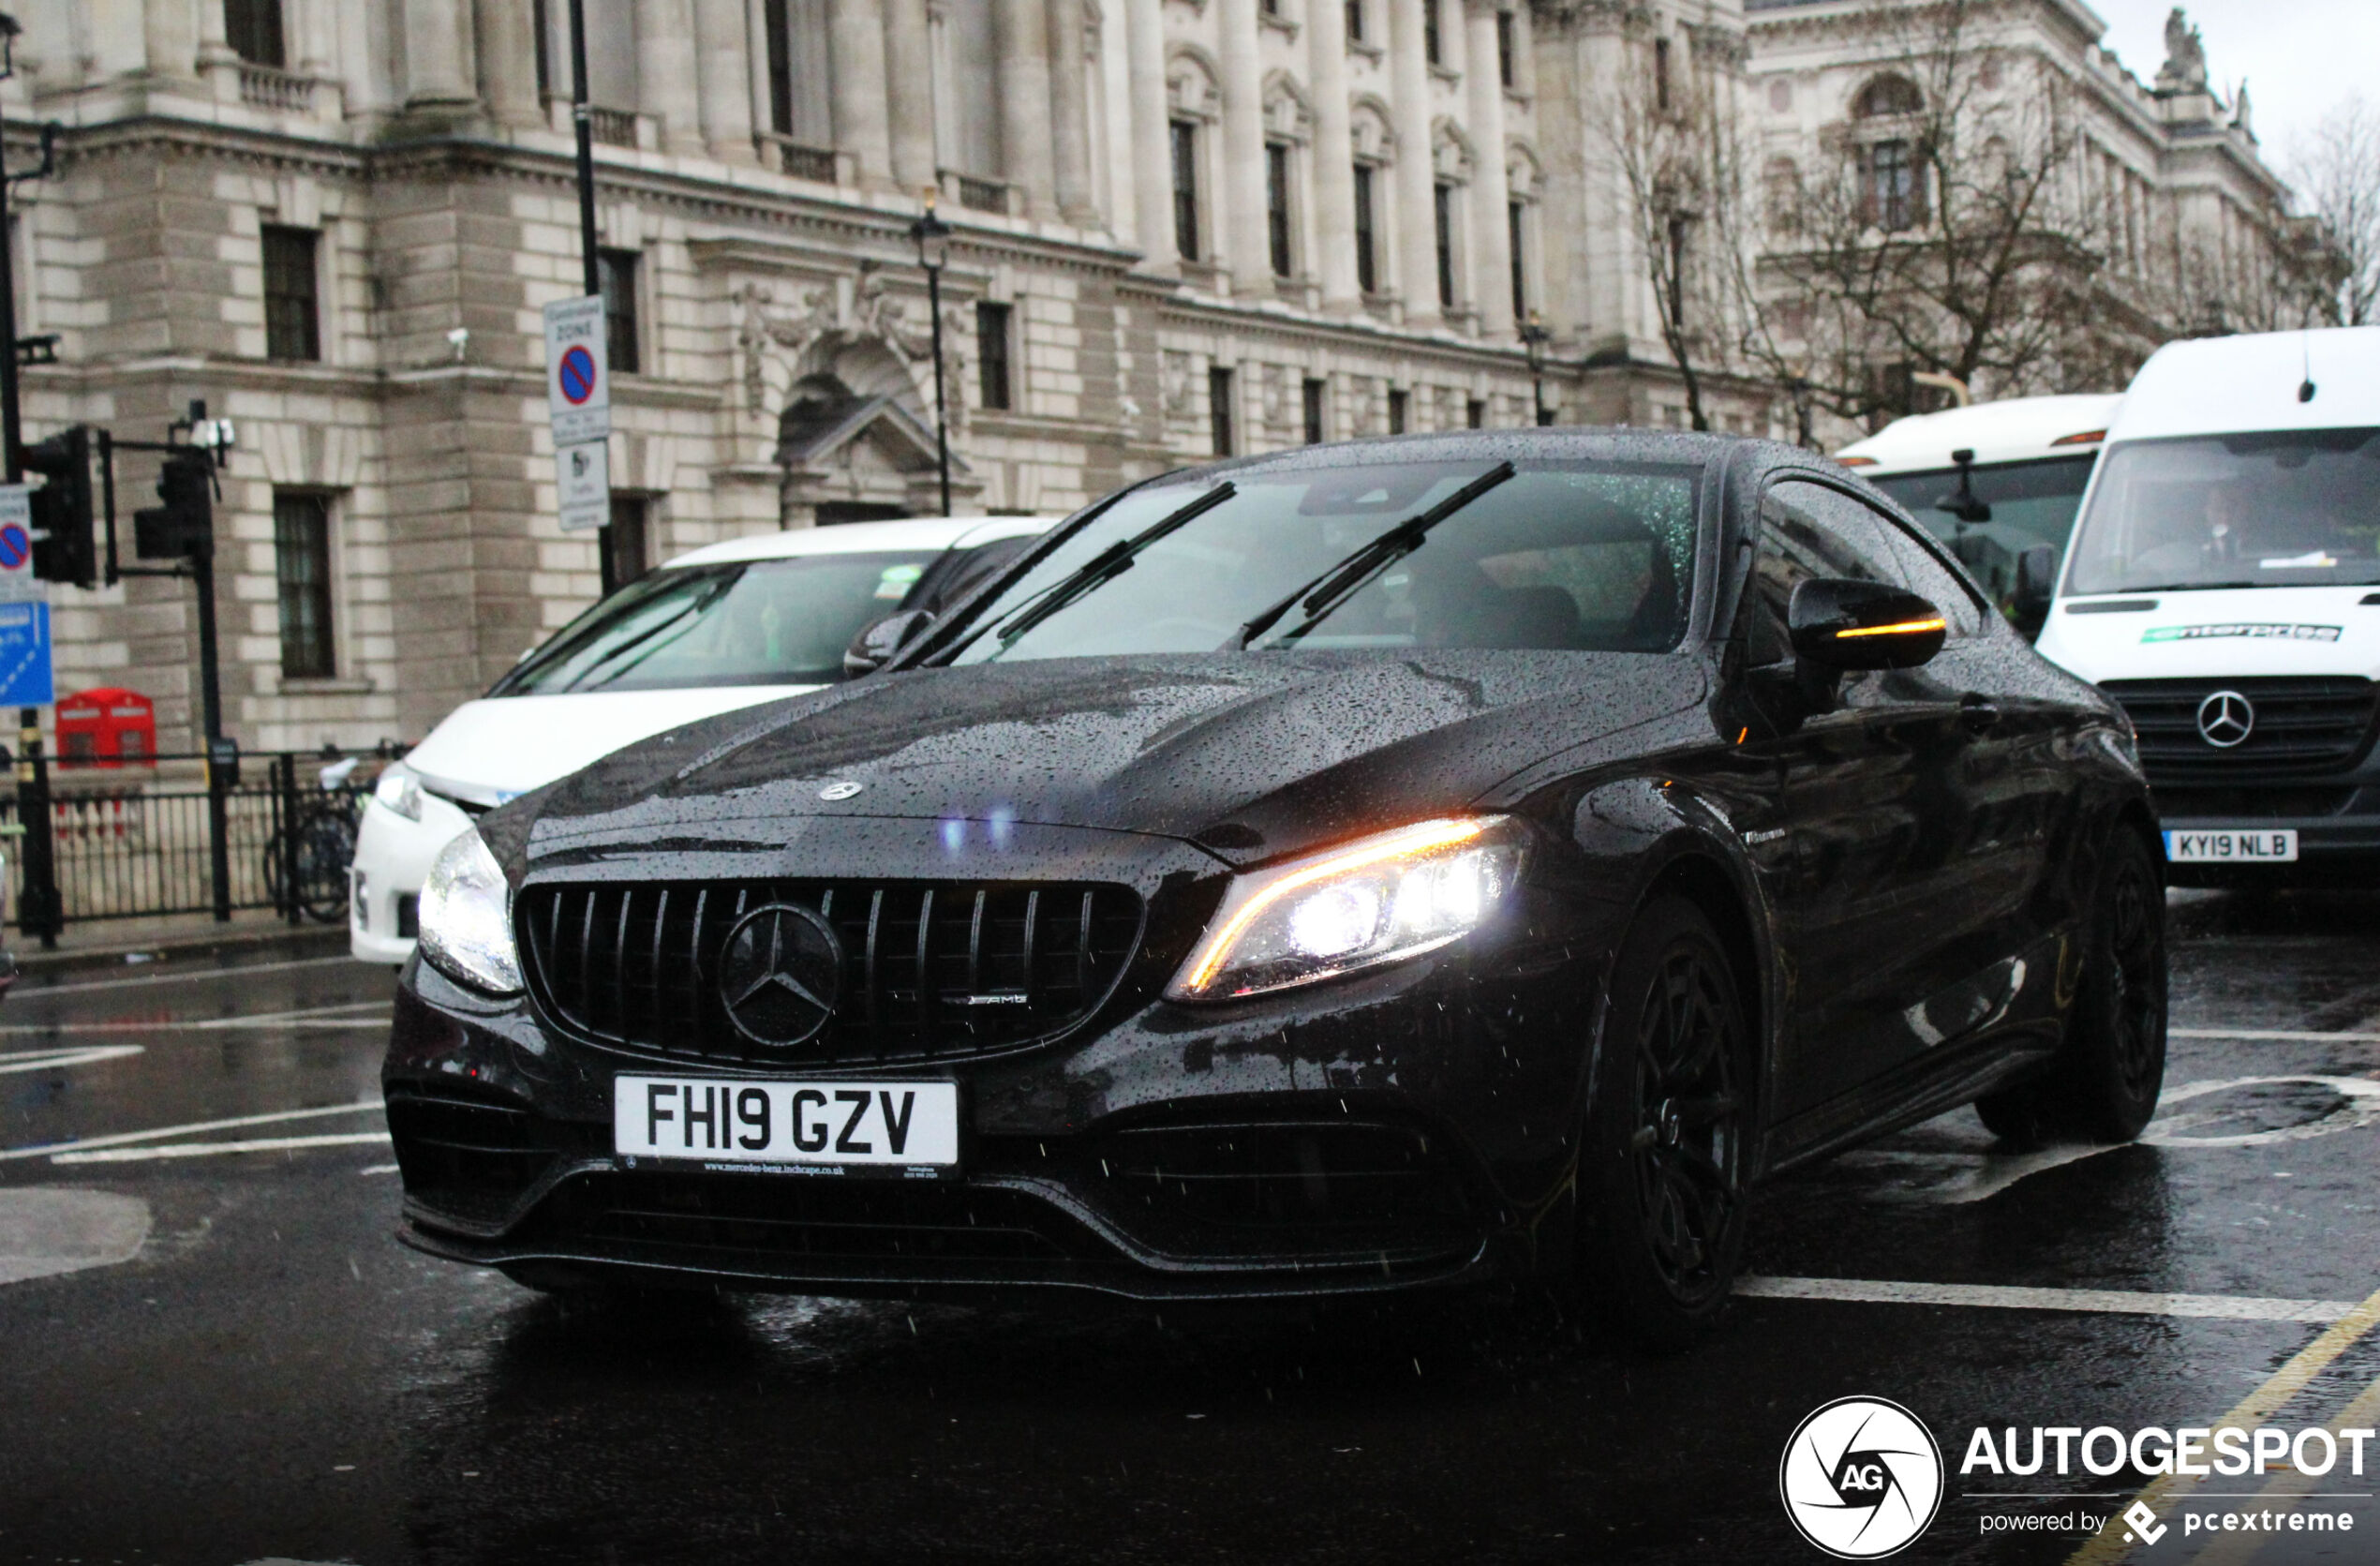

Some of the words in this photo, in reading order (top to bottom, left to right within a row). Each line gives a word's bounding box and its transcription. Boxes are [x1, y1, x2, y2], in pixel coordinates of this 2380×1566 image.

[556, 321, 592, 341] ZONE
[2149, 623, 2341, 641] enterprise
[2180, 835, 2231, 857] KY19
[2239, 835, 2287, 857] NLB
[987, 995, 1028, 1005] AMG
[647, 1083, 771, 1151] FH19
[792, 1088, 915, 1155] GZV
[705, 1162, 845, 1176] www.mercedes-benz.inchcape.co.uk
